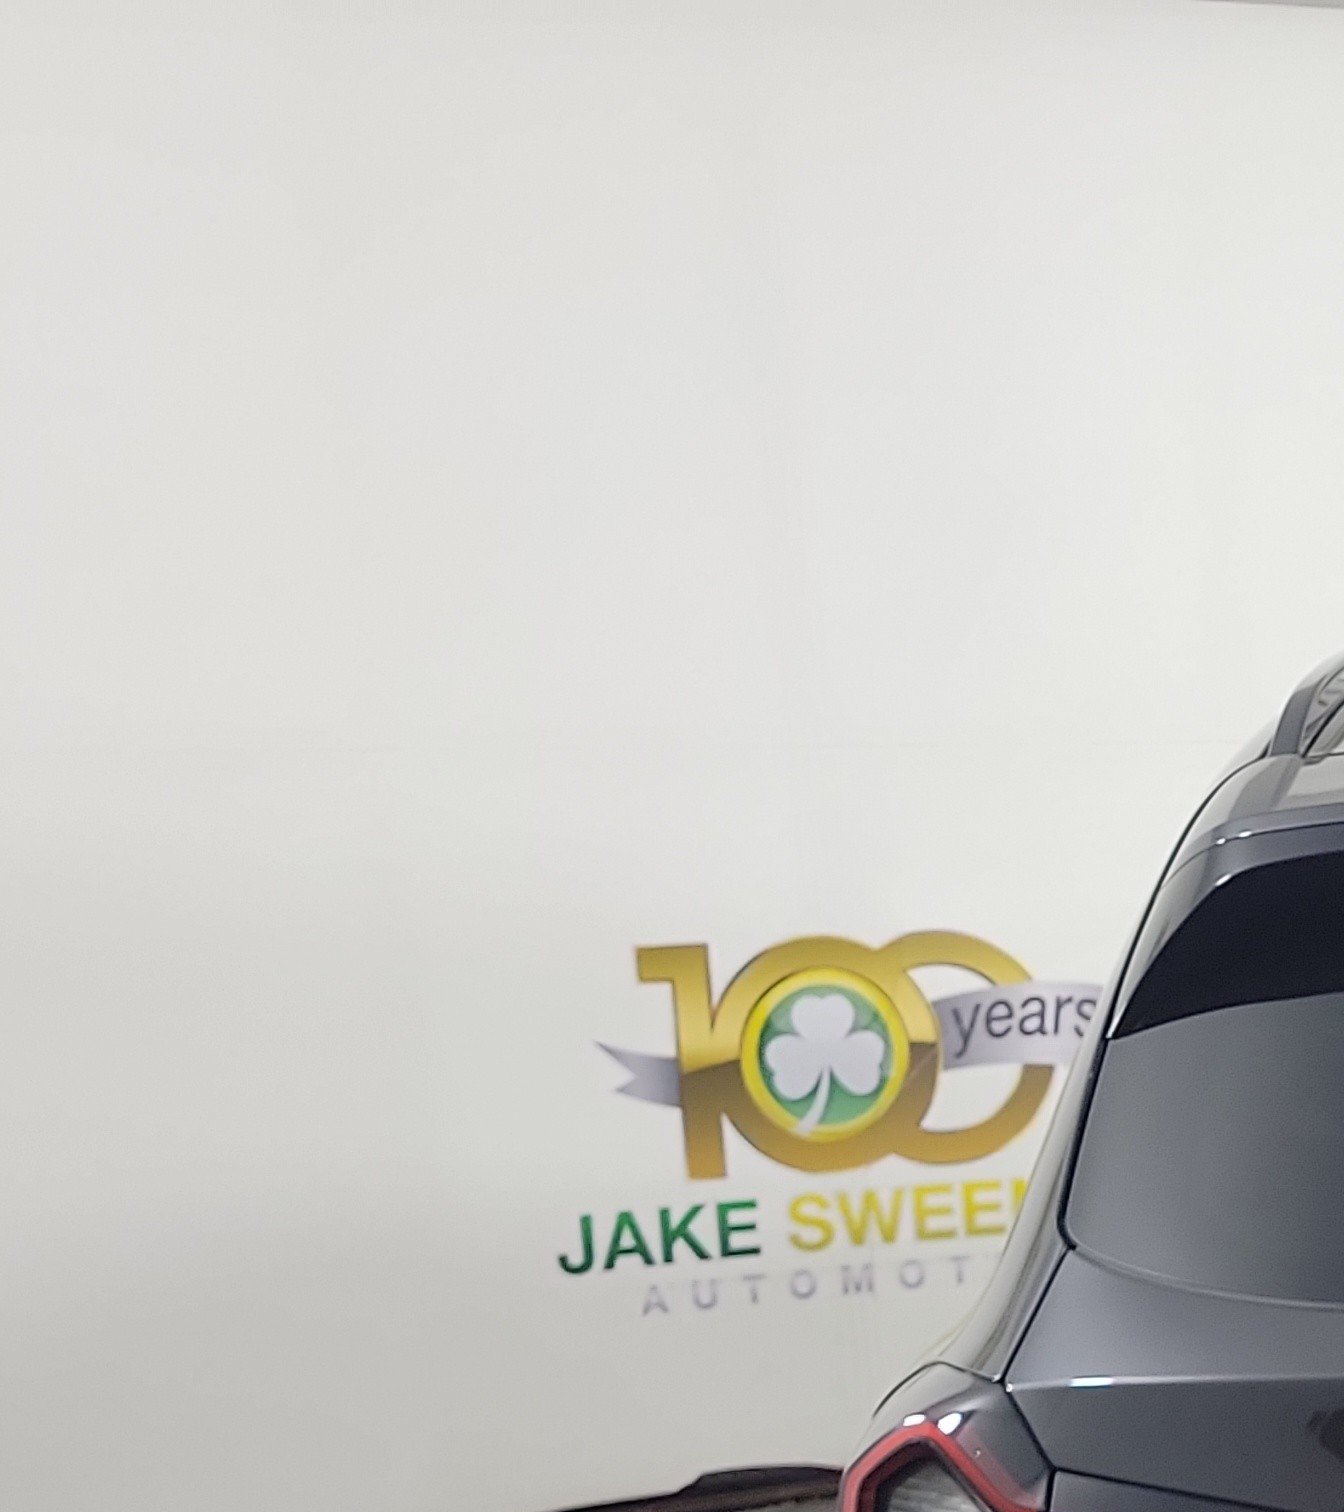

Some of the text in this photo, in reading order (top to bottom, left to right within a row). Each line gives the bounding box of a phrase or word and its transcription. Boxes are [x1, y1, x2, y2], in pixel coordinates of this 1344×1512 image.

[635, 929, 1054, 1181] 100
[558, 1178, 1028, 1275] JAKE SWEE
